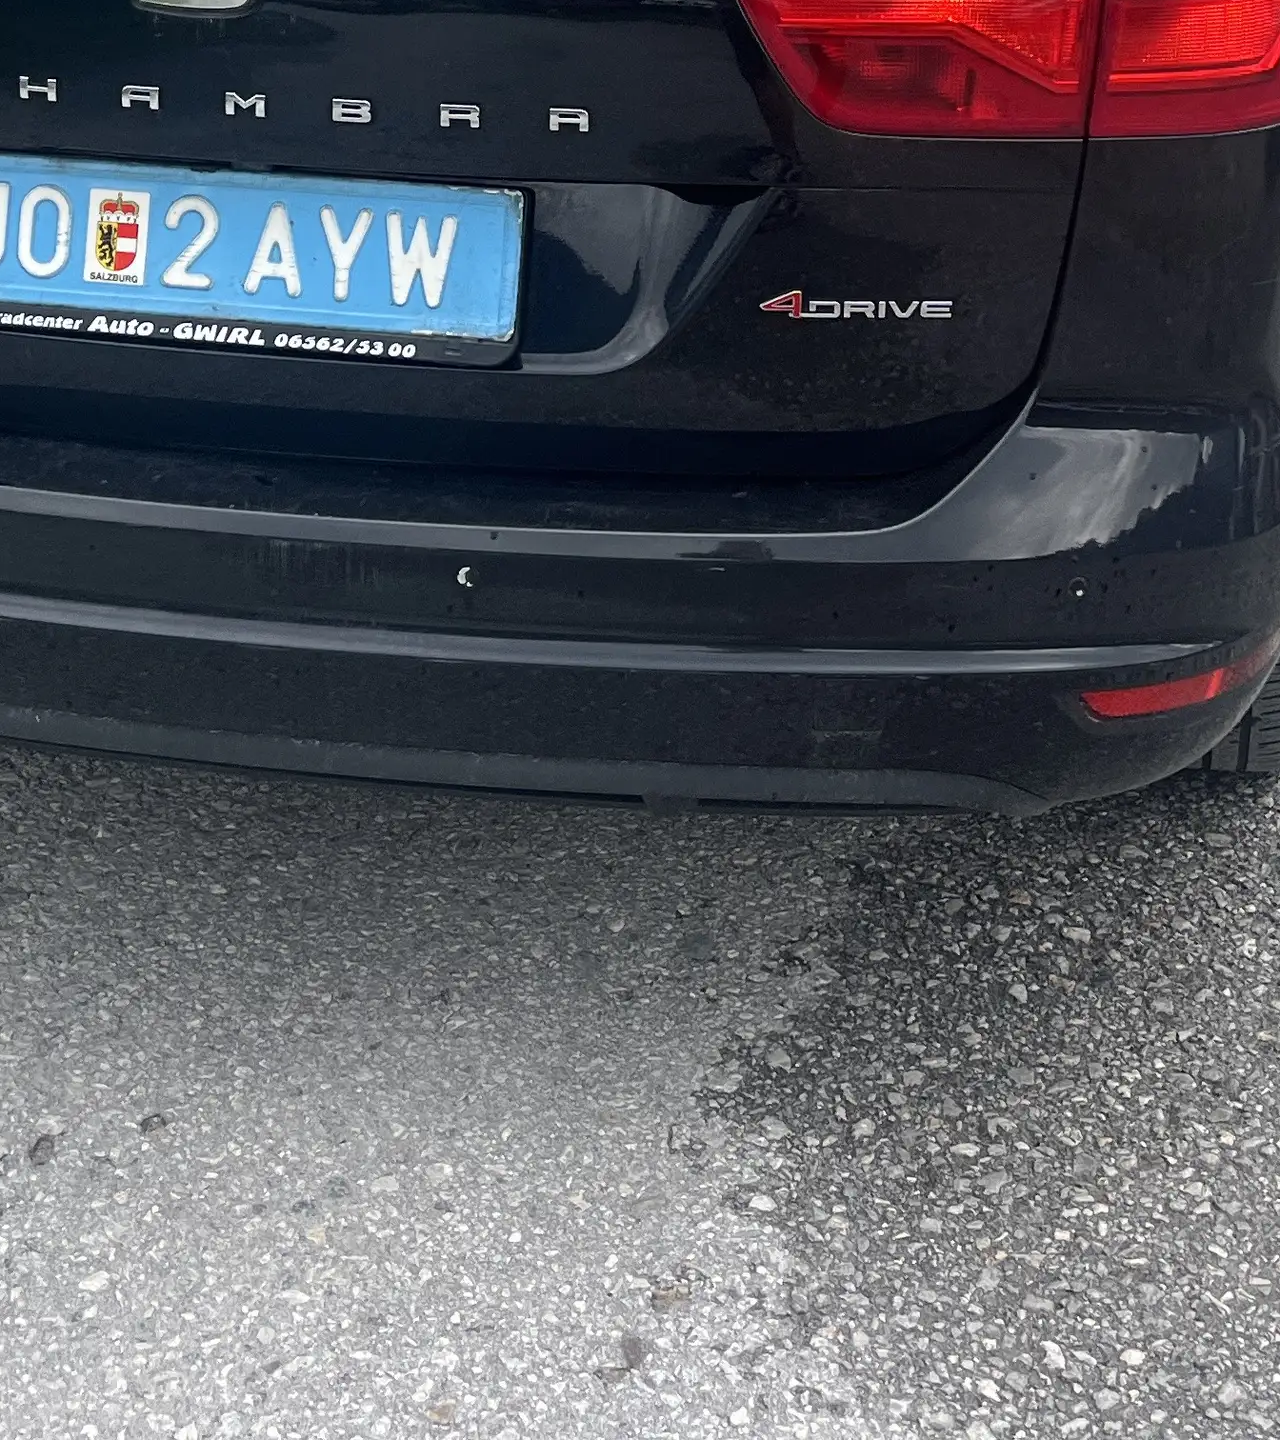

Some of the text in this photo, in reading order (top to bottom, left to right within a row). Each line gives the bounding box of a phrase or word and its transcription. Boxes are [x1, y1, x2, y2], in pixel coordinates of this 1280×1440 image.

[160, 193, 218, 290] 2
[243, 200, 459, 309] AYW
[89, 271, 139, 284] SALZBURG
[758, 289, 954, 319] 4DRIVE
[86, 314, 155, 337] Auto
[173, 322, 266, 347] GWIRL
